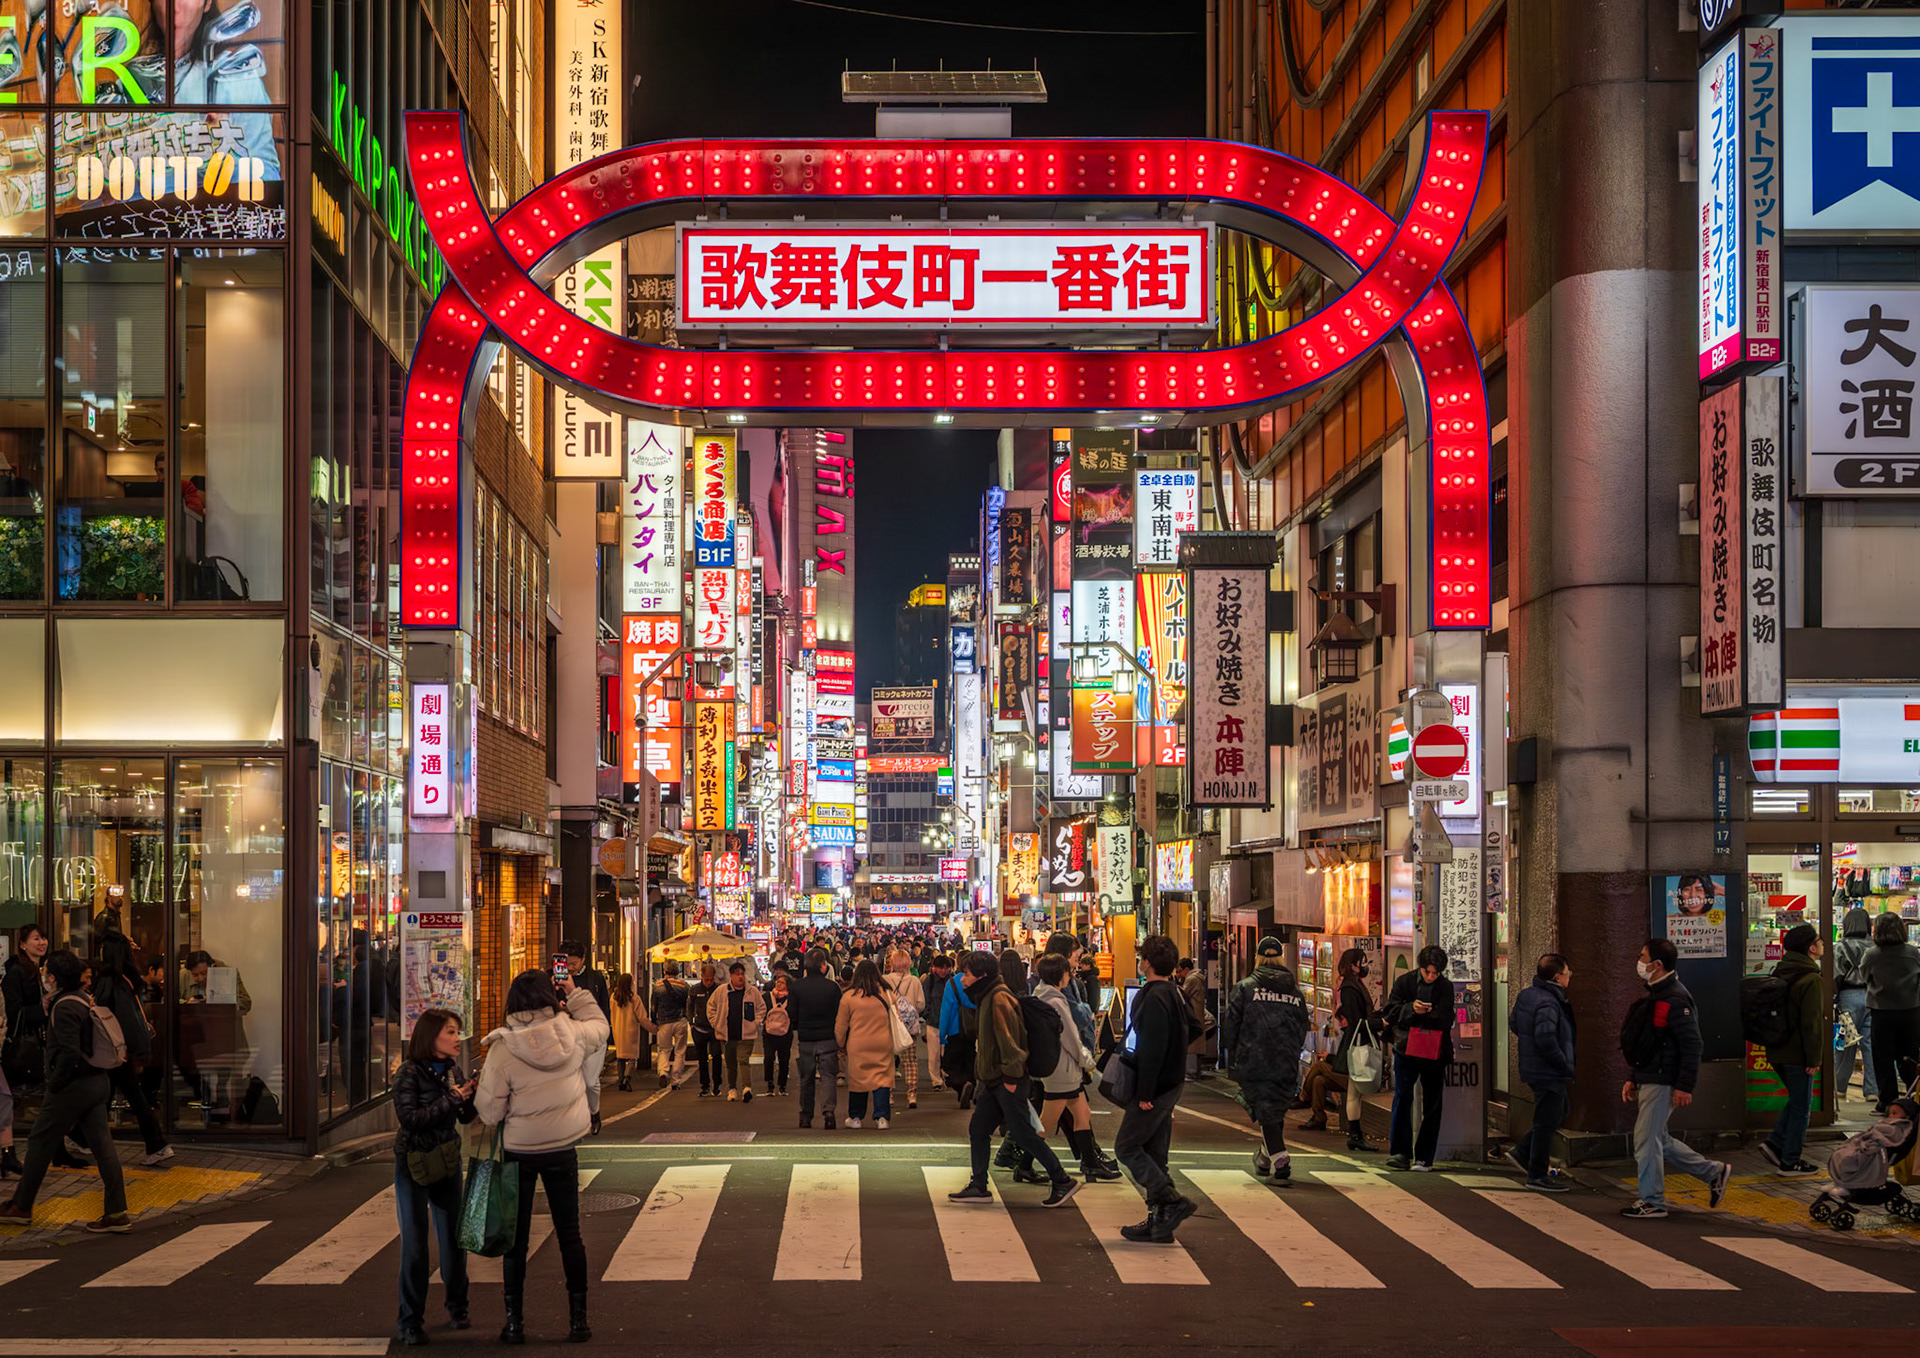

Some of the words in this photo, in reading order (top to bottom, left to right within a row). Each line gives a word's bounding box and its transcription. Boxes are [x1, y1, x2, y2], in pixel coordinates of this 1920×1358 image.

[569, 50, 583, 162] 美容外科・歯科
[77, 151, 265, 201] DOUTOR
[1749, 62, 1776, 246] ファイトフィット
[1711, 106, 1724, 337] ファイトフィット
[701, 242, 1190, 311] 歌舞伎町一番街
[1756, 249, 1770, 333] 新宿東口駅前
[1712, 345, 1727, 371] B2F
[1750, 343, 1776, 357] B2F
[704, 442, 726, 541] まぐろ商店
[1139, 474, 1196, 486] 全卓全自動
[1860, 462, 1920, 484] 2F
[630, 473, 659, 574] バンタイ
[663, 474, 676, 568] タイ国料理専門店
[1151, 488, 1173, 562] 東南荘
[1711, 410, 1728, 624] お好み焼き
[1751, 437, 1777, 644] 歌舞伎町名物
[698, 548, 732, 562] B1F
[1139, 552, 1150, 562] 3F
[641, 597, 662, 608] 3F
[626, 620, 679, 645] 焼肉
[1164, 578, 1186, 682] ハイボール
[1216, 577, 1243, 706] お好み焼き
[1704, 631, 1737, 679] 本陣
[705, 688, 725, 698] 4F
[1706, 679, 1735, 708] HONJIN
[421, 694, 442, 805] 劇場通り
[1091, 691, 1119, 760] ステップ
[1215, 714, 1245, 777] 本陣
[879, 758, 946, 767] ゴールドラッシュ
[1202, 781, 1258, 799] HONJIN
[1415, 784, 1465, 798] 自転車を除く
[814, 827, 855, 841] SAUNA
[1717, 831, 1729, 841] 17
[1116, 905, 1132, 913] B1F
